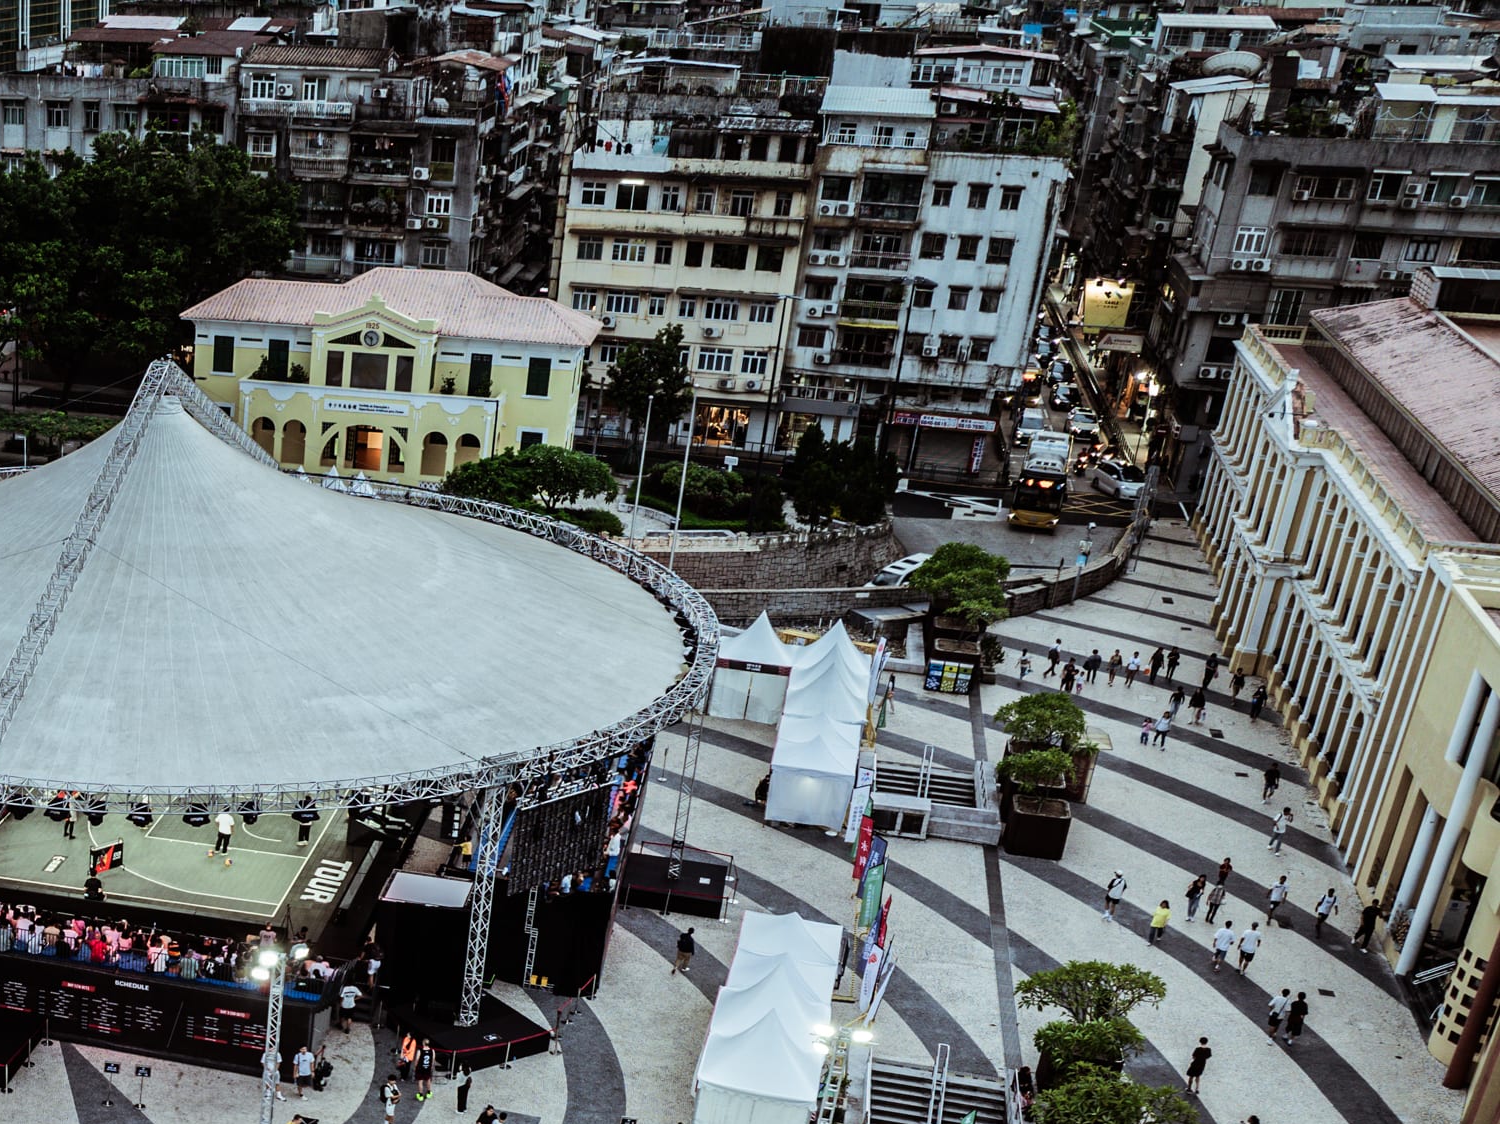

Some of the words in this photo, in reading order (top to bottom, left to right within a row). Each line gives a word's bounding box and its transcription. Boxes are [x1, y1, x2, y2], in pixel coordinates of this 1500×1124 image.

[300, 858, 353, 904] TOUR
[114, 979, 150, 992] SCHEDULE
[423, 1055, 431, 1065] 2
